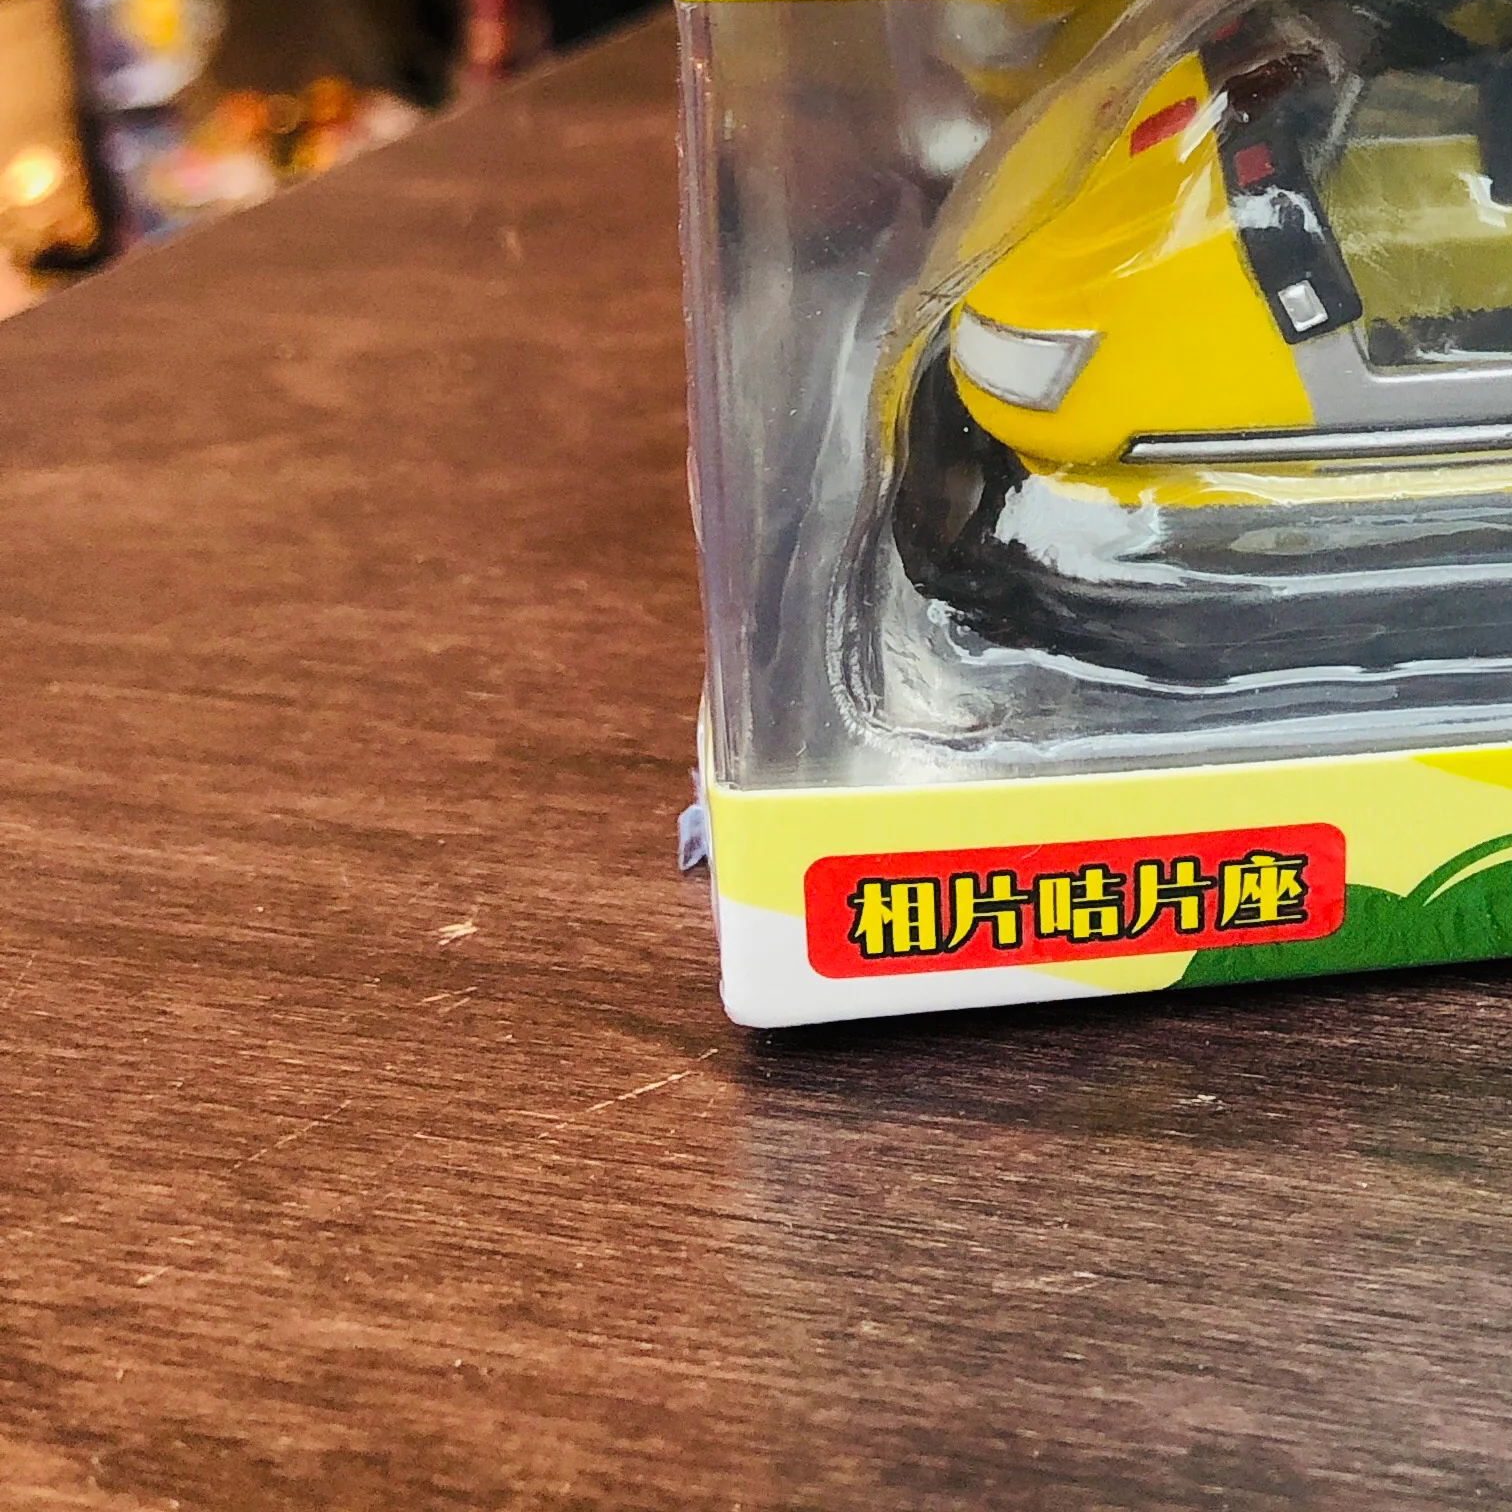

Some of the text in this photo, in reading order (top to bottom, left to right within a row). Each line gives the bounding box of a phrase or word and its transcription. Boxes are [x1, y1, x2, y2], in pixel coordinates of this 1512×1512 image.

[850, 849, 1308, 959] 相片咭片座
